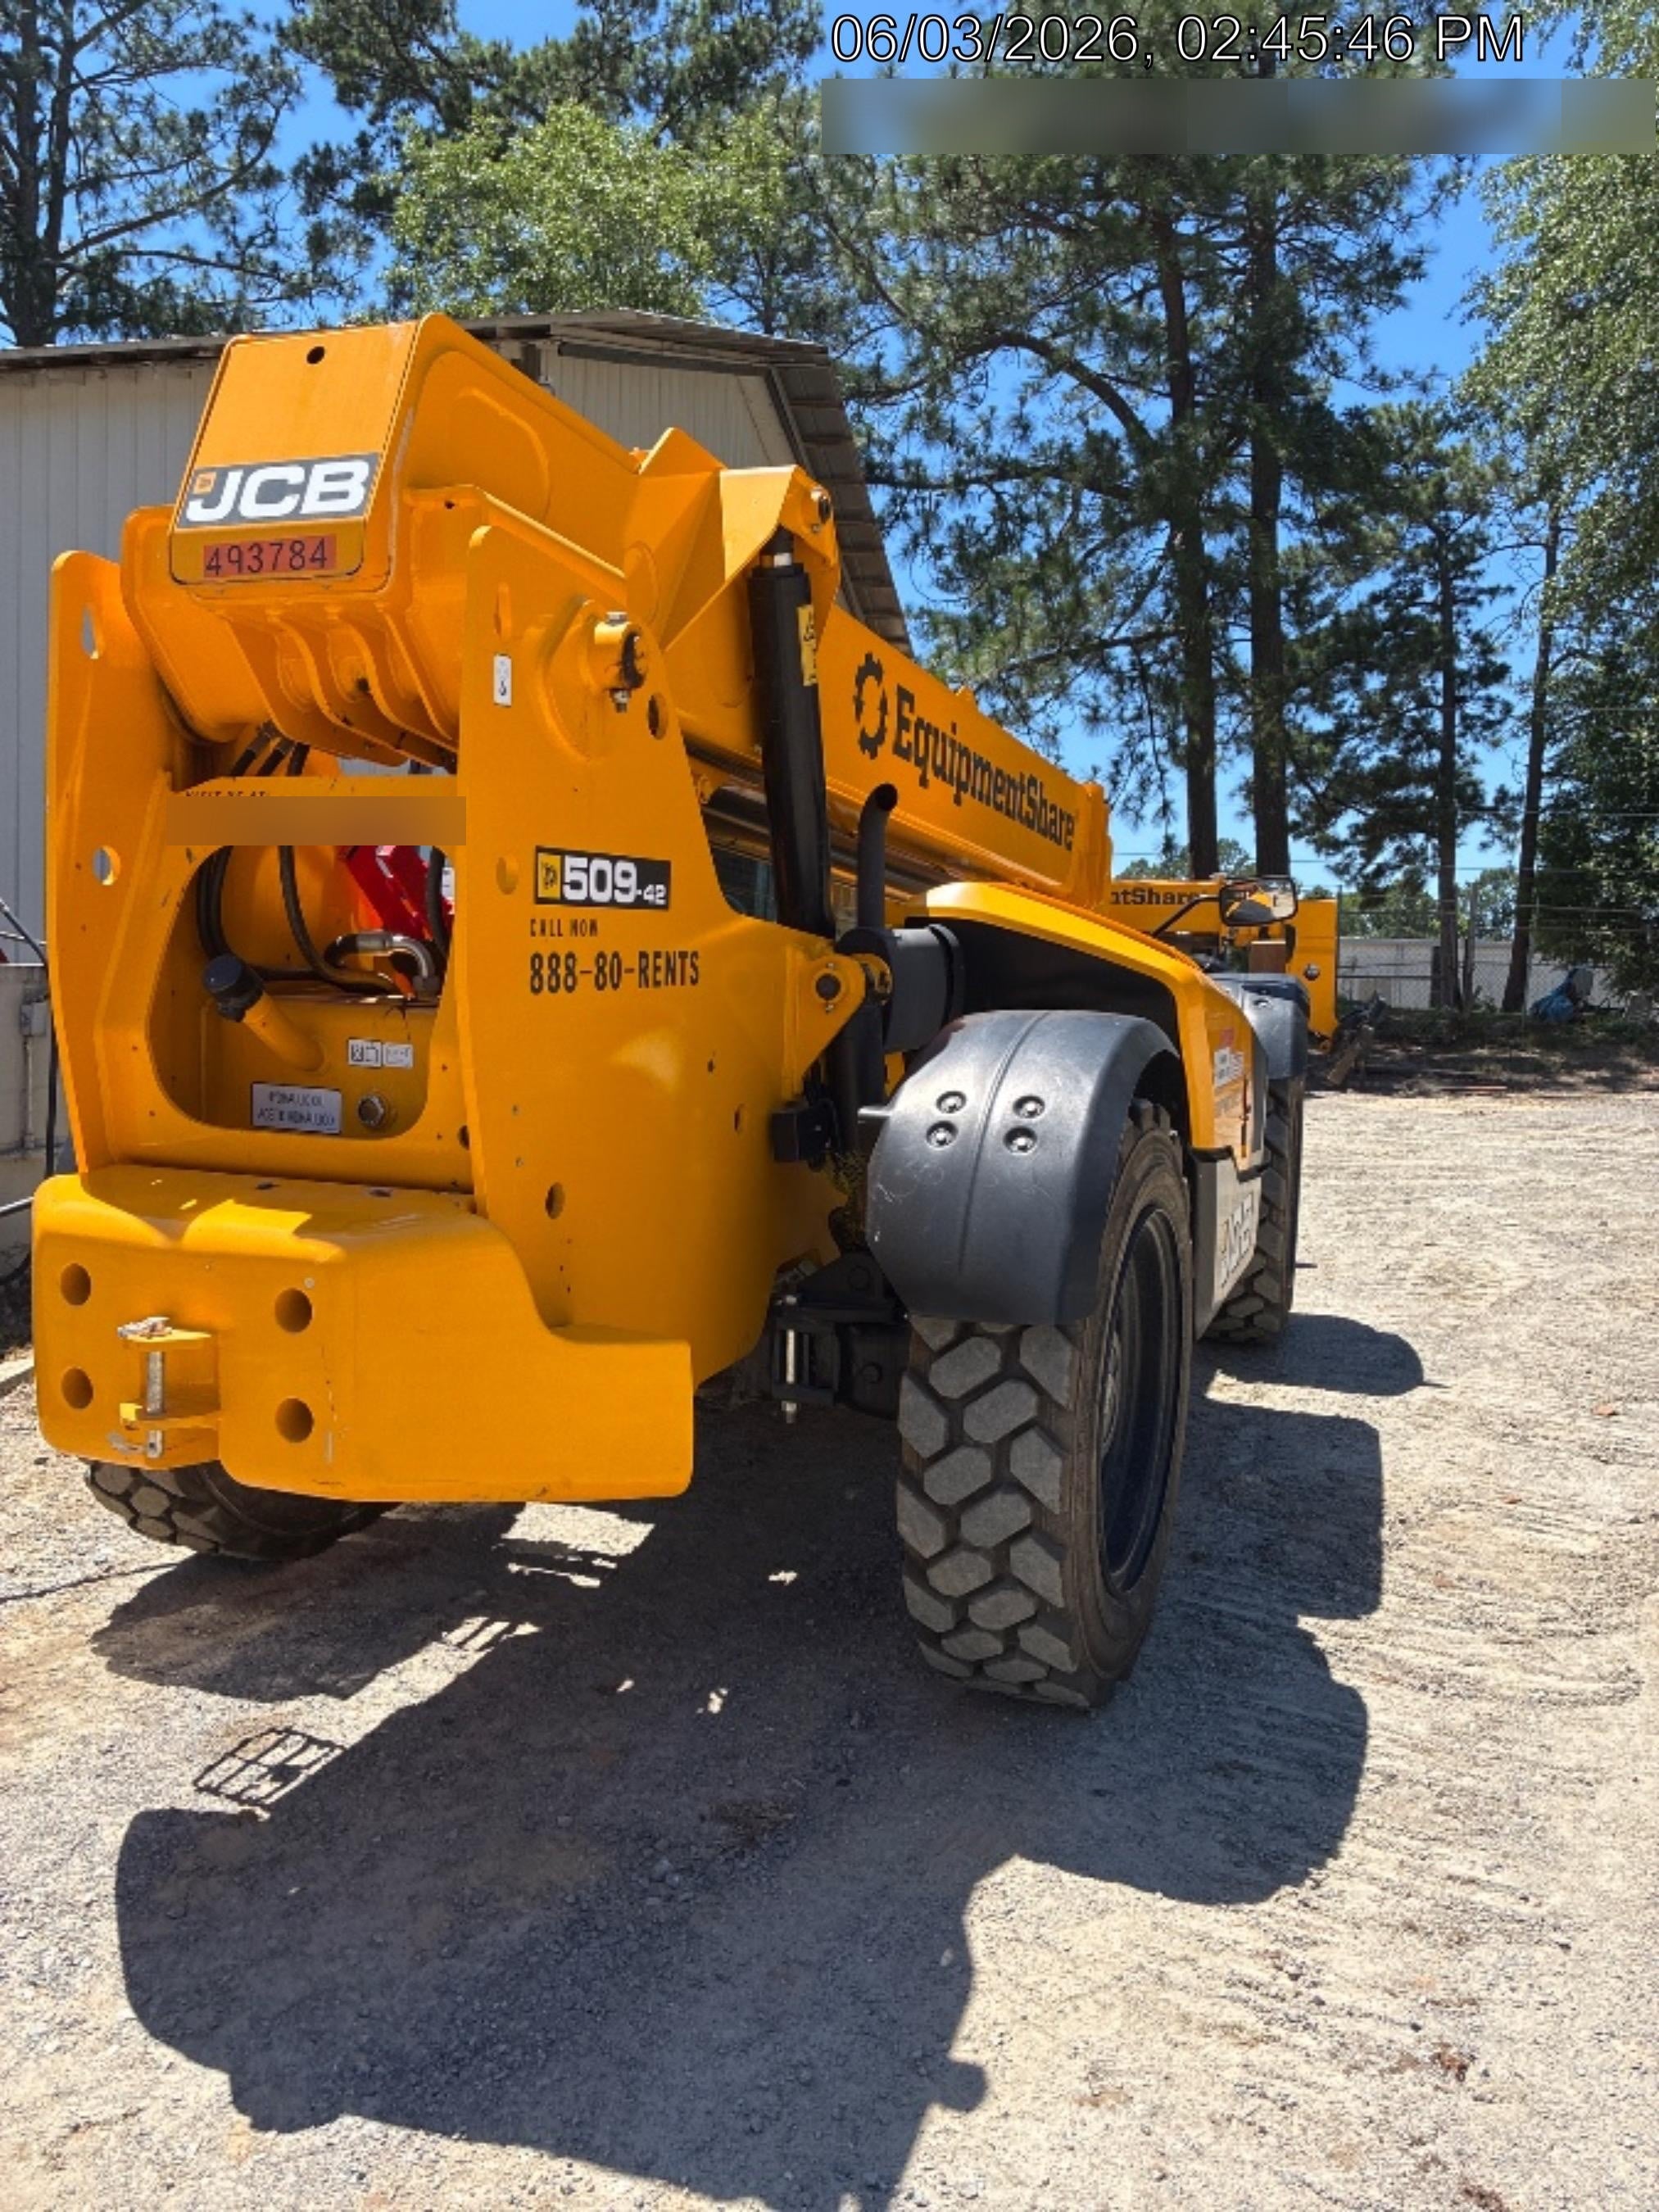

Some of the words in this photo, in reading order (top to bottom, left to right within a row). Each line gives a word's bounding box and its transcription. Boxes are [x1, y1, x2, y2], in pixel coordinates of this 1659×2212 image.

[185, 459, 370, 522] JCB
[205, 537, 328, 577] 493784
[891, 683, 1076, 852] EquipmentShare
[529, 918, 564, 937] CALL
[569, 918, 598, 937] NOW
[530, 950, 700, 995] 888-80-RENTS
